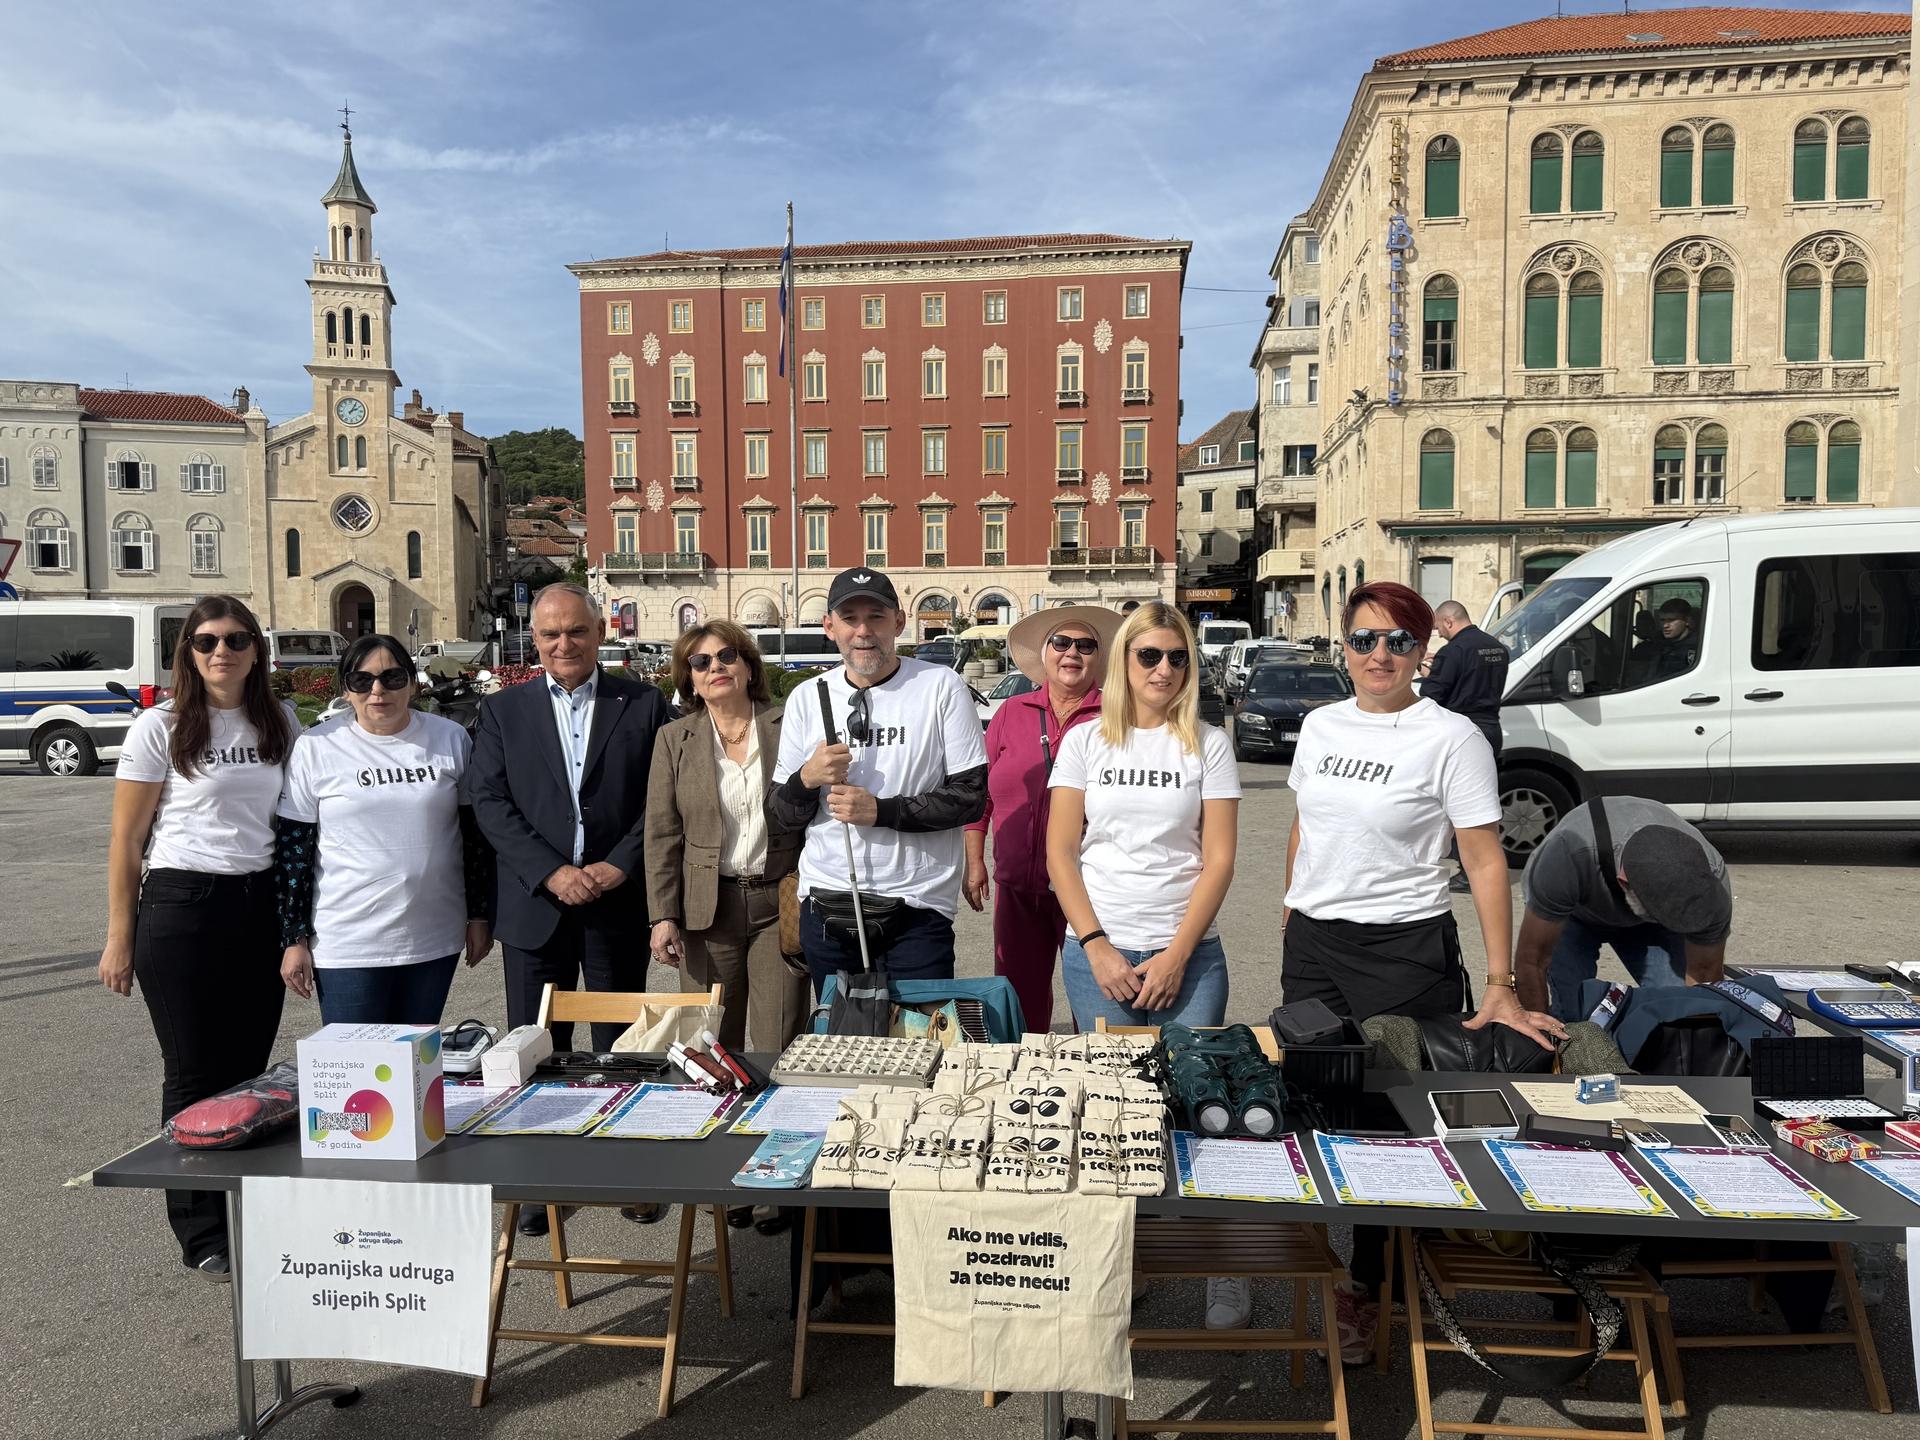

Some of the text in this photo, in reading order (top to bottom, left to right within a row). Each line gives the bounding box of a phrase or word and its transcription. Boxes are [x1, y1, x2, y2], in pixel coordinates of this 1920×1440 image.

[1316, 752, 1394, 785] (S)LIJEPI
[356, 765, 437, 788] (S)LIJEPI
[1099, 767, 1181, 789] (S)LIJEPI
[312, 1058, 365, 1070] Županijska
[312, 1071, 347, 1080] udruga
[313, 1080, 352, 1089] slijepih
[313, 1090, 337, 1099] Split
[316, 1141, 362, 1150] 75 godina
[358, 1228, 392, 1238] Županijska
[947, 1227, 1068, 1250] Ako me vidiš,
[358, 1237, 381, 1245] udruga
[966, 1251, 1055, 1269] pozdravi!
[281, 1254, 455, 1285] Županijska udruga
[949, 1270, 1071, 1292] Ja tebe neću!
[312, 1289, 427, 1314] slijepih Split
[974, 1298, 1003, 1307] Županijska
